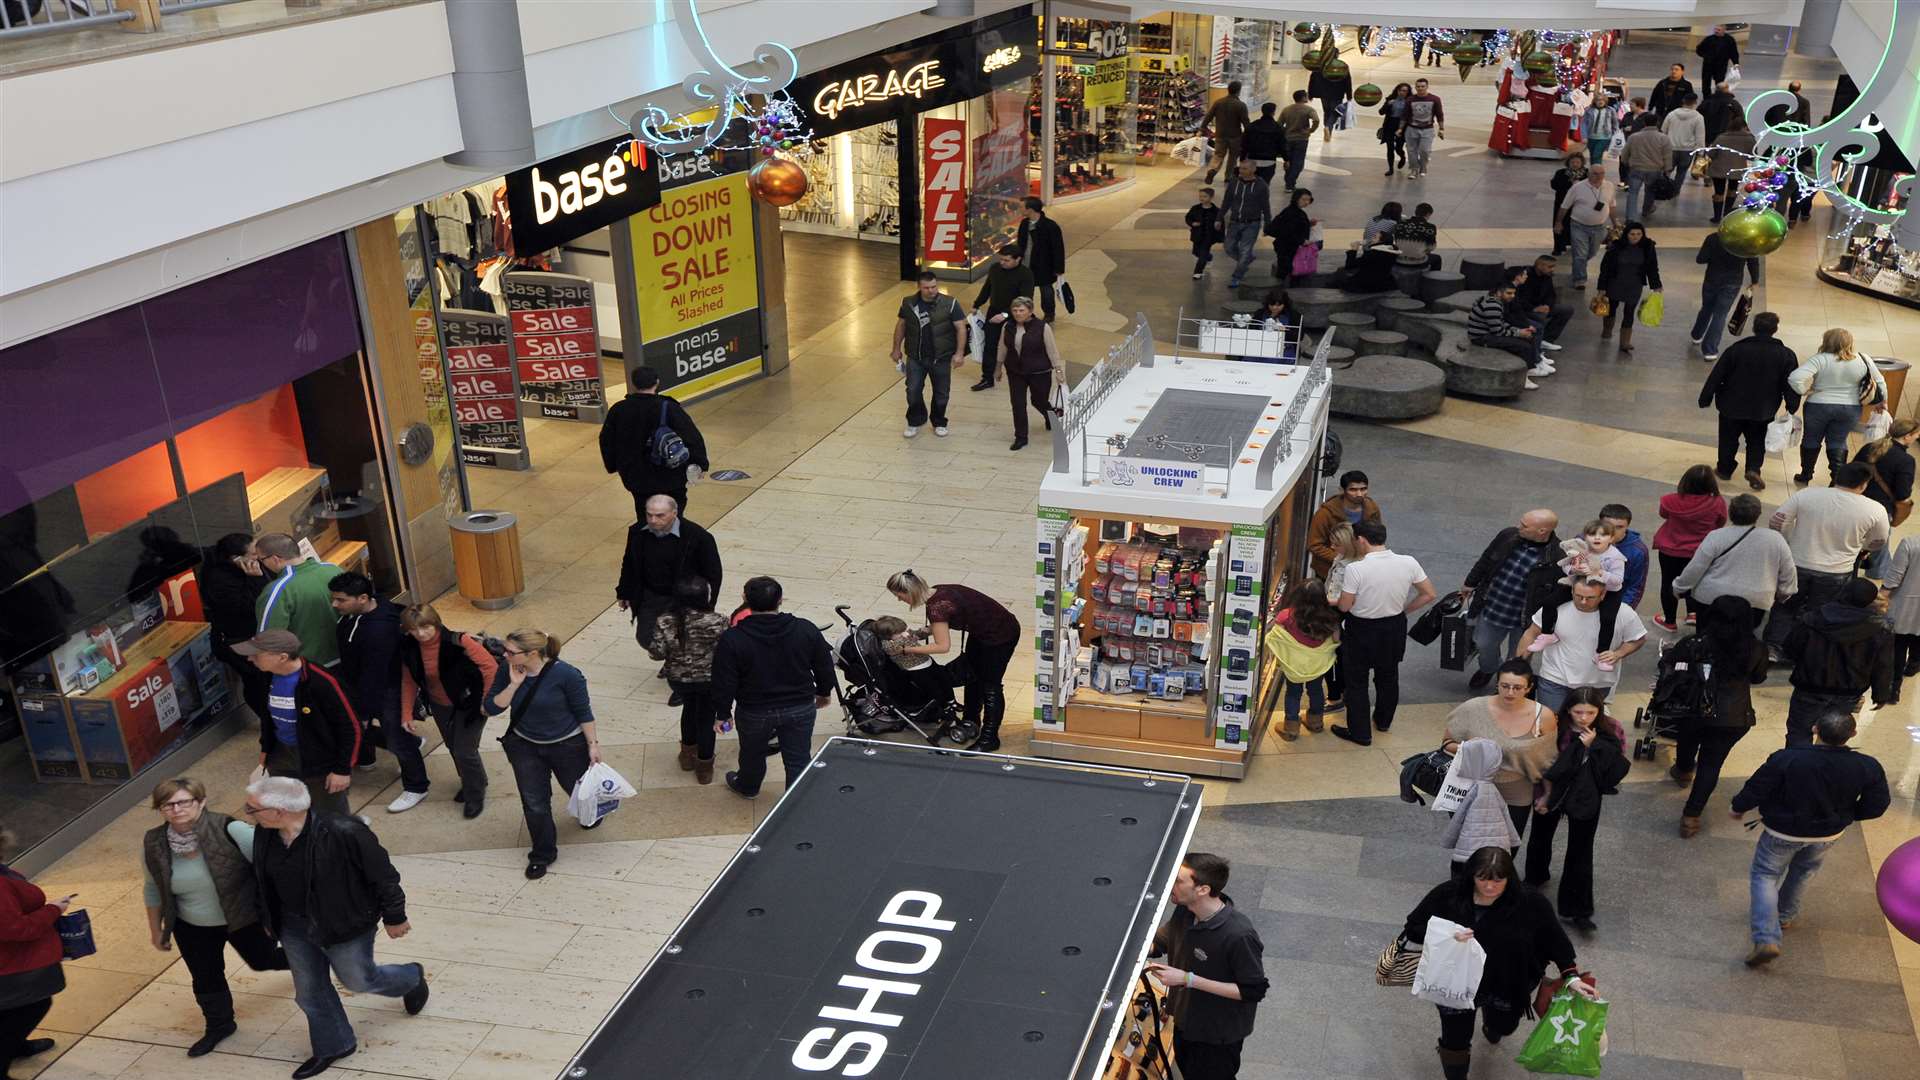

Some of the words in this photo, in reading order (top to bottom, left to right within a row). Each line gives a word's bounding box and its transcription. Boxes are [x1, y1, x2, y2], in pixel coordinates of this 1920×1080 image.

[1088, 24, 1127, 58] 50%
[813, 59, 946, 120] GARAGE
[1086, 71, 1126, 87] REDUCED
[658, 153, 711, 183] base
[532, 153, 628, 226] base
[927, 130, 964, 252] SALE
[649, 187, 731, 224] CLOSING
[652, 213, 733, 257] DOWN
[661, 248, 730, 290] SALE
[670, 292, 686, 308] All
[690, 283, 724, 304] Prices
[523, 312, 579, 332] Sale
[677, 298, 724, 322] Slashed
[466, 321, 507, 337] Sale
[526, 335, 580, 356] Sale
[674, 328, 720, 355] mens
[532, 361, 587, 381] Sale
[675, 345, 727, 378] base
[453, 376, 498, 395] ale
[568, 391, 591, 400] base
[544, 406, 569, 418] base
[485, 434, 509, 444] base
[1141, 466, 1198, 479] UNLOCKING
[1154, 477, 1184, 488] CREW
[142, 616, 154, 631] 43
[126, 673, 164, 710] Sale
[1446, 784, 1469, 797] THND
[792, 890, 957, 1078] SHOP
